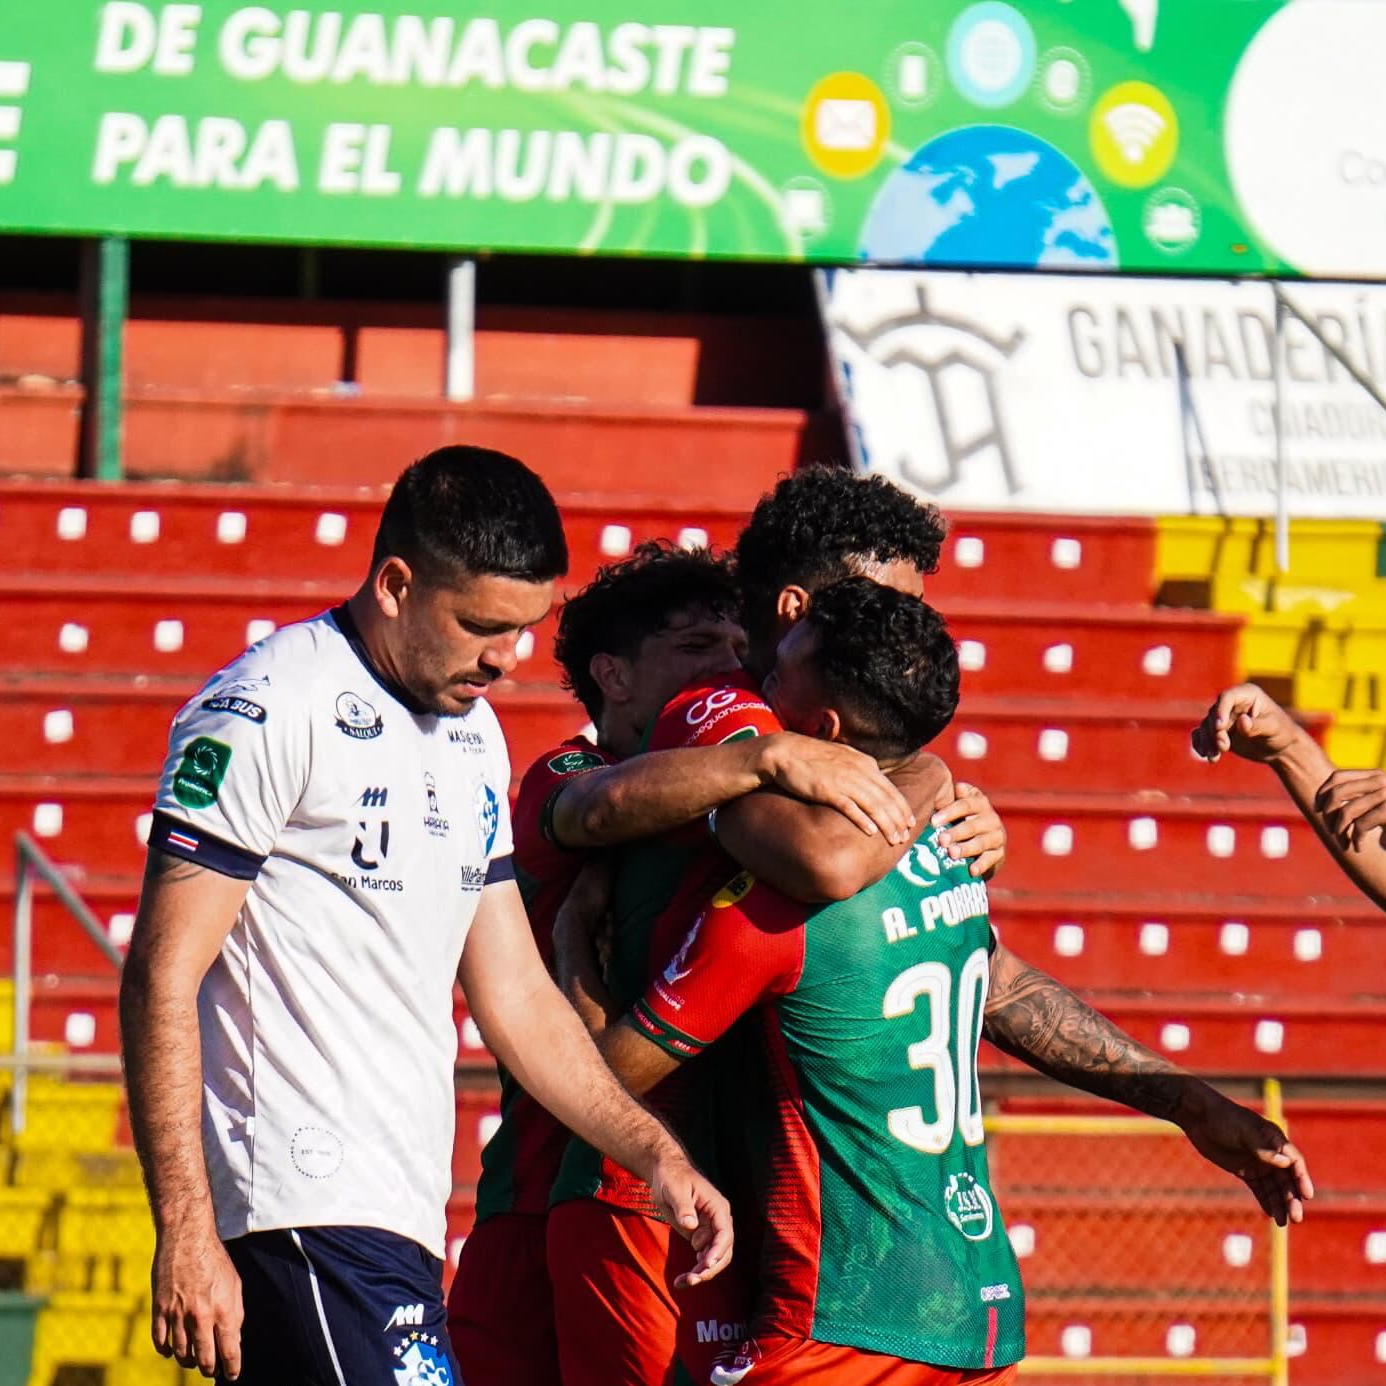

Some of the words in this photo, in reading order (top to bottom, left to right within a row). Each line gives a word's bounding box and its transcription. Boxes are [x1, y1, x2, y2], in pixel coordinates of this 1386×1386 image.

[94, 1, 201, 77] DE
[216, 6, 735, 98] GUANACASTE
[92, 112, 298, 191] PARA
[318, 120, 401, 197] EL
[418, 126, 733, 206] MUNDO
[361, 875, 404, 892] Marcos
[881, 906, 918, 944] A.
[883, 947, 990, 1155] 30
